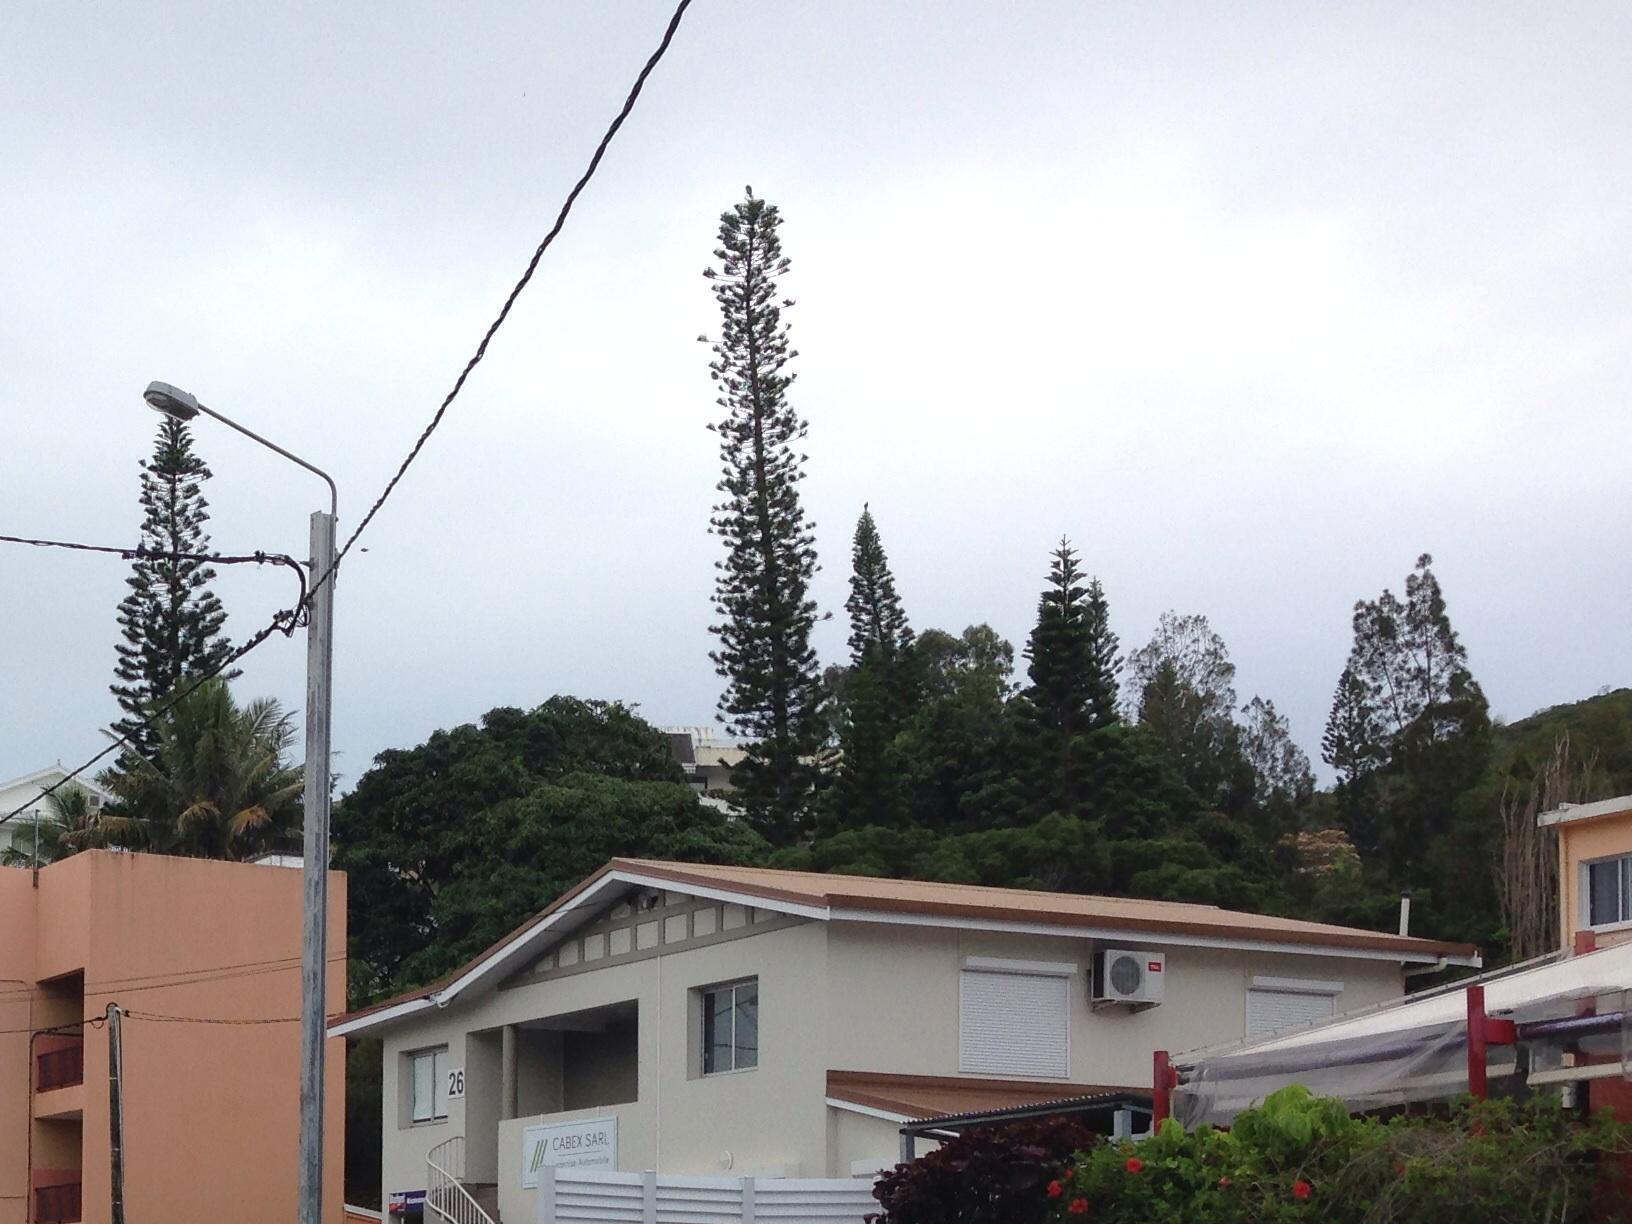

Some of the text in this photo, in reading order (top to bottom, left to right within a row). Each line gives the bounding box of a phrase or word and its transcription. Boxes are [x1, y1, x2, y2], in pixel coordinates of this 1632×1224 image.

[448, 1071, 464, 1095] 26
[552, 1132, 609, 1150] CABEX SARL
